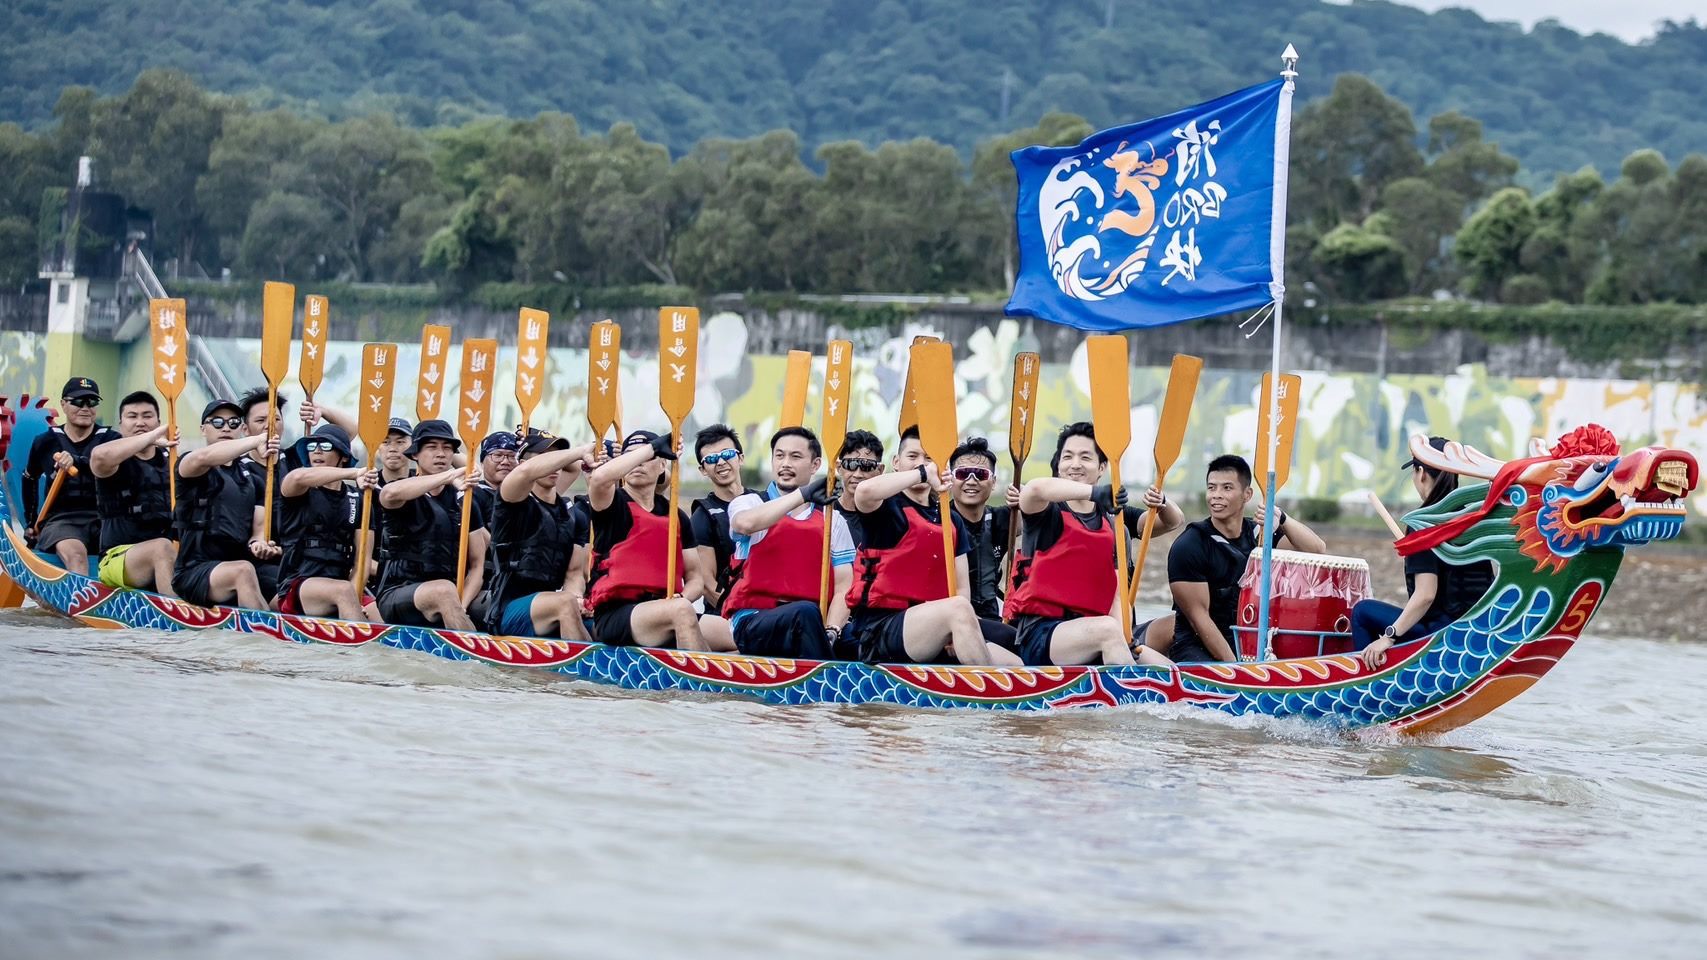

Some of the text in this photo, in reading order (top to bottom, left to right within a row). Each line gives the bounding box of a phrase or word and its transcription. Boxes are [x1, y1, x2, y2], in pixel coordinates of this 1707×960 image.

[368, 347, 388, 413] 大會用
[596, 327, 613, 397] 大會用
[668, 312, 687, 383] 大會用
[828, 344, 844, 417] 大會用
[1560, 593, 1593, 632] 5
